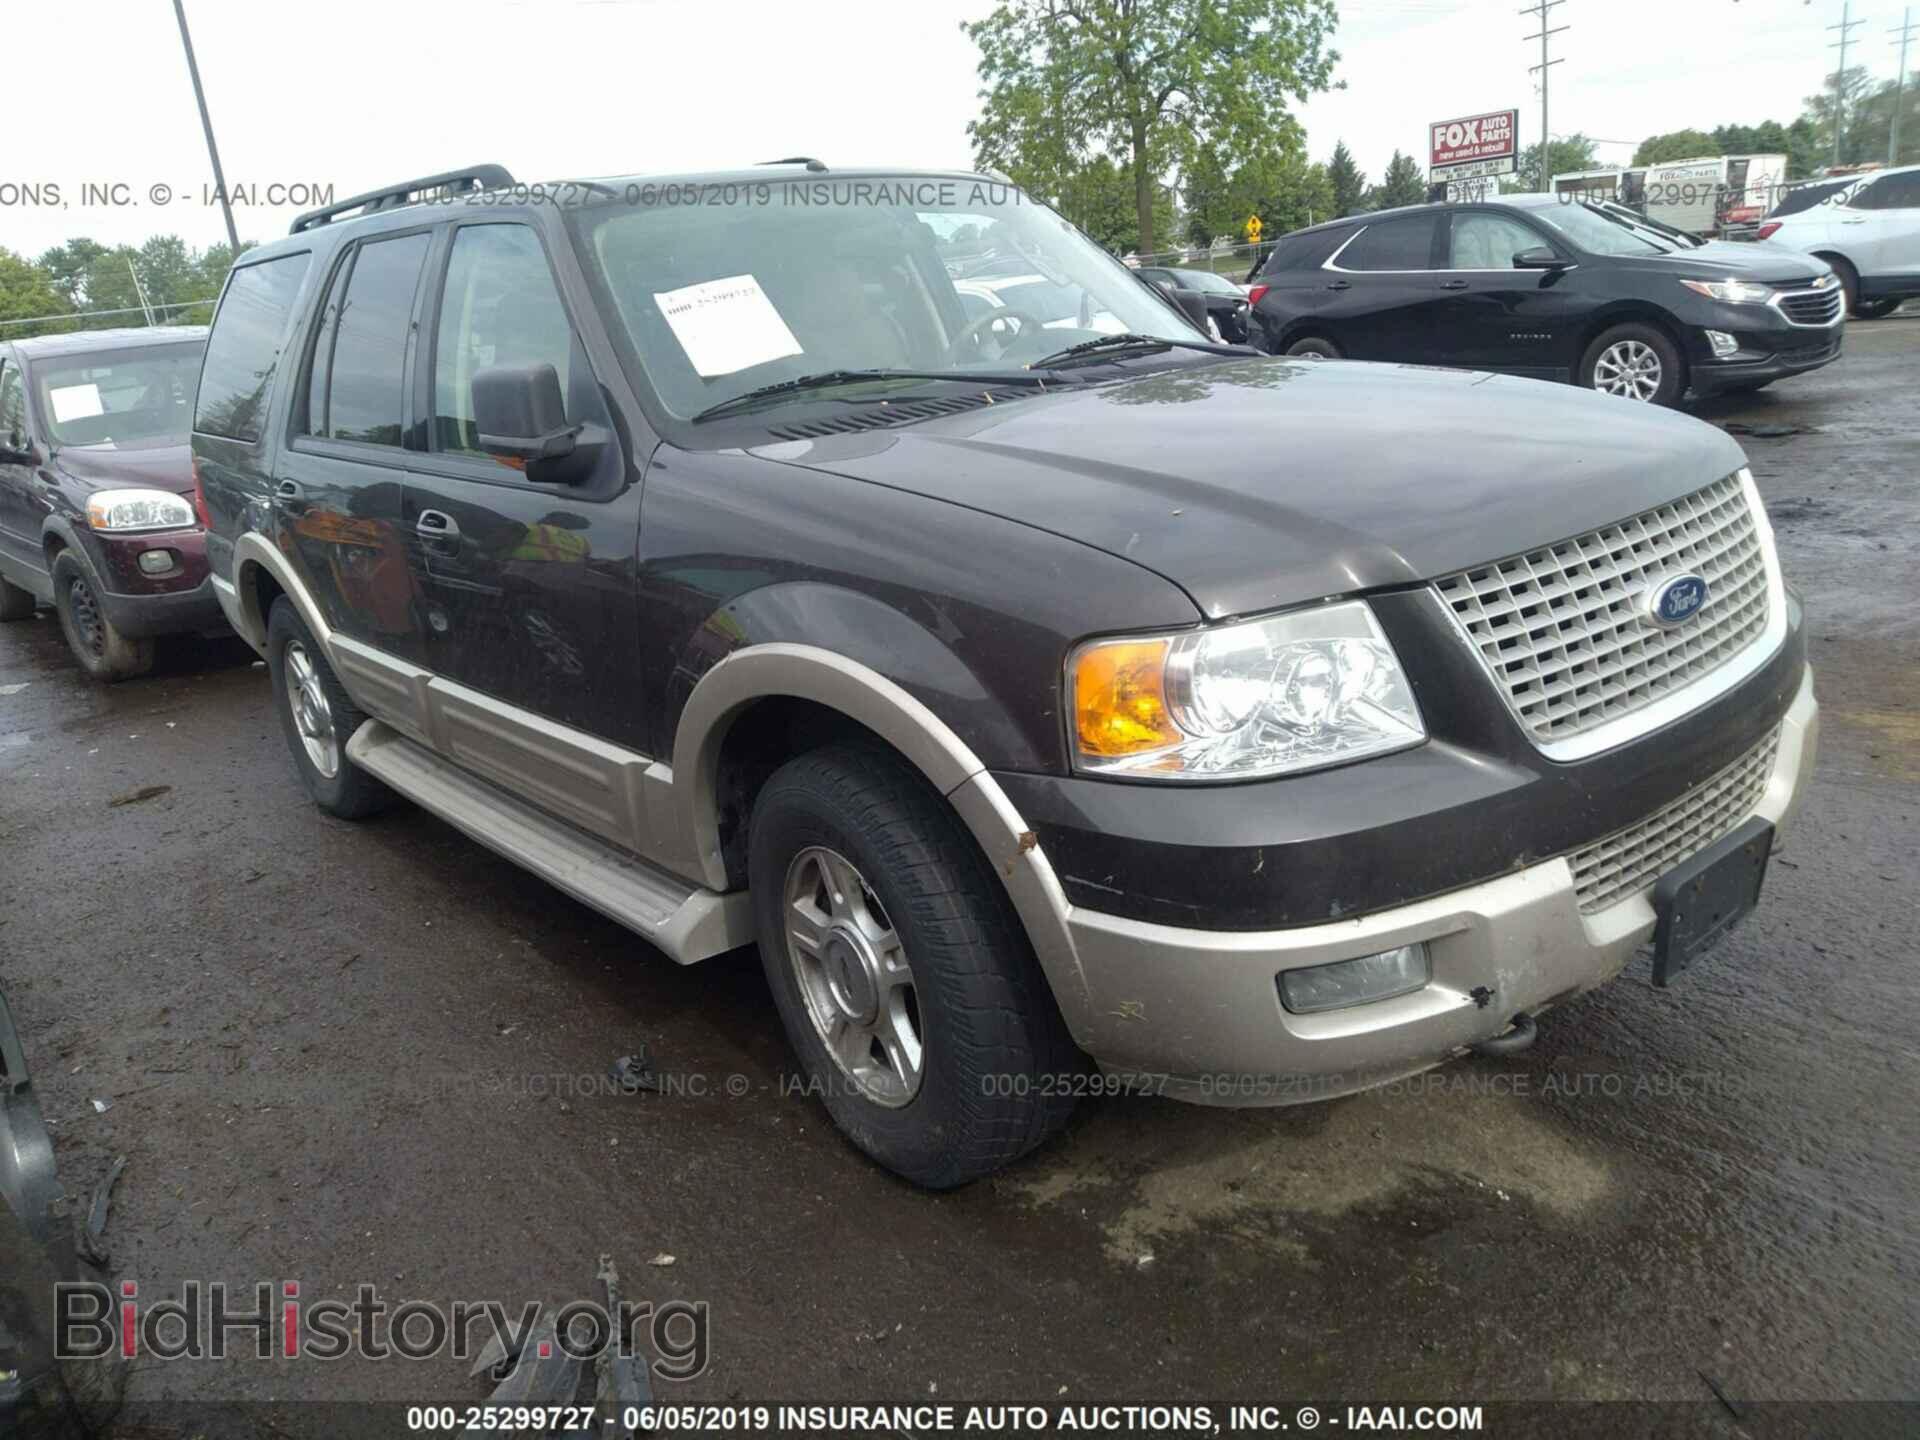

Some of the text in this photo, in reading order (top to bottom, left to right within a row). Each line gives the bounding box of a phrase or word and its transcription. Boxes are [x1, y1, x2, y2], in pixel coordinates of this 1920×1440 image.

[1434, 116, 1508, 150] FOX AUTO
[1481, 128, 1511, 142] PARTS
